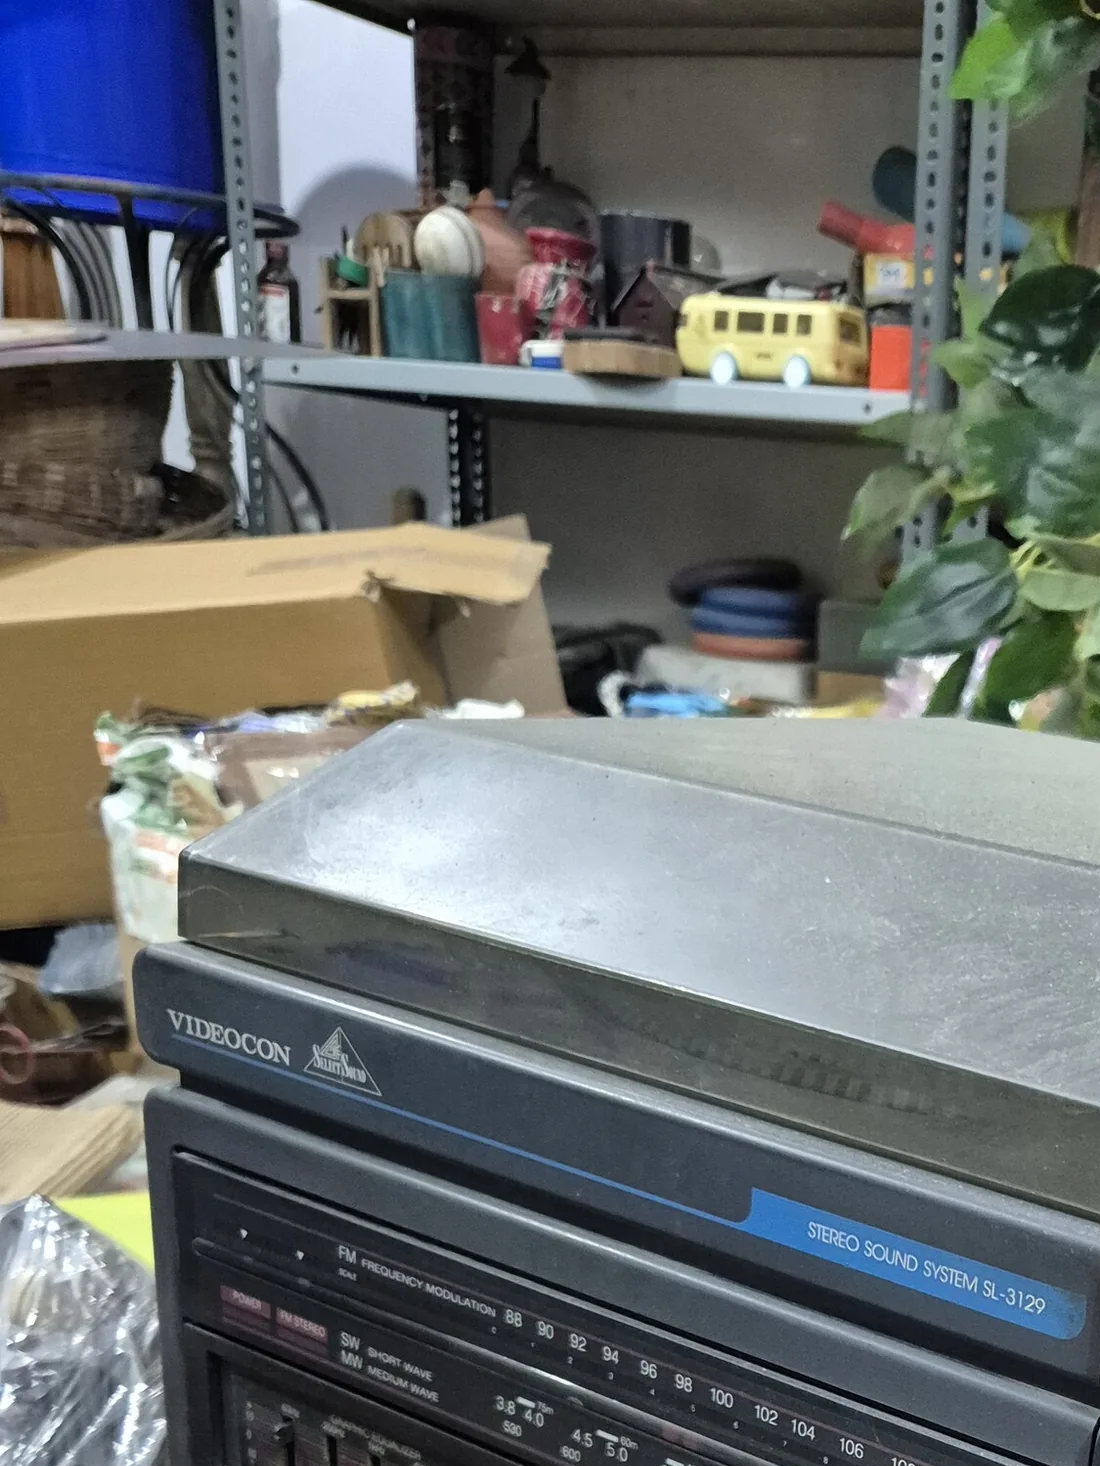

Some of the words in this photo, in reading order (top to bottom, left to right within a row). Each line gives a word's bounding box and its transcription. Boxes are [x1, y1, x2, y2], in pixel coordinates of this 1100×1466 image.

[166, 1008, 291, 1067] VIDEOCON
[807, 1221, 861, 1252] STEREO
[863, 1240, 919, 1273] SOUND
[922, 1260, 979, 1294] SYSTEM
[982, 1280, 1046, 1315] SL-3129
[338, 1244, 357, 1264] FM
[361, 1258, 423, 1290] FREQUENCY
[425, 1281, 497, 1319] MODULATION
[504, 1309, 522, 1328] 88
[537, 1321, 554, 1340] 90
[569, 1333, 587, 1352] 92
[602, 1346, 619, 1365] 94
[640, 1360, 658, 1380] 96
[674, 1373, 693, 1393] 98
[710, 1387, 734, 1409] 100
[754, 1404, 779, 1426] 102
[790, 1418, 816, 1441] 104
[839, 1437, 864, 1459] 106
[340, 1330, 361, 1350] SW
[367, 1346, 402, 1368] SHORT
[404, 1360, 433, 1382] WAVE
[341, 1350, 363, 1370] MW
[366, 1365, 408, 1389] MEDIUM
[410, 1379, 440, 1402] WAVE
[496, 1395, 516, 1416] 3.8
[523, 1407, 545, 1429] 4.0
[571, 1428, 593, 1448] 4.5
[605, 1442, 628, 1463] 5.0
[503, 1421, 522, 1437] 530
